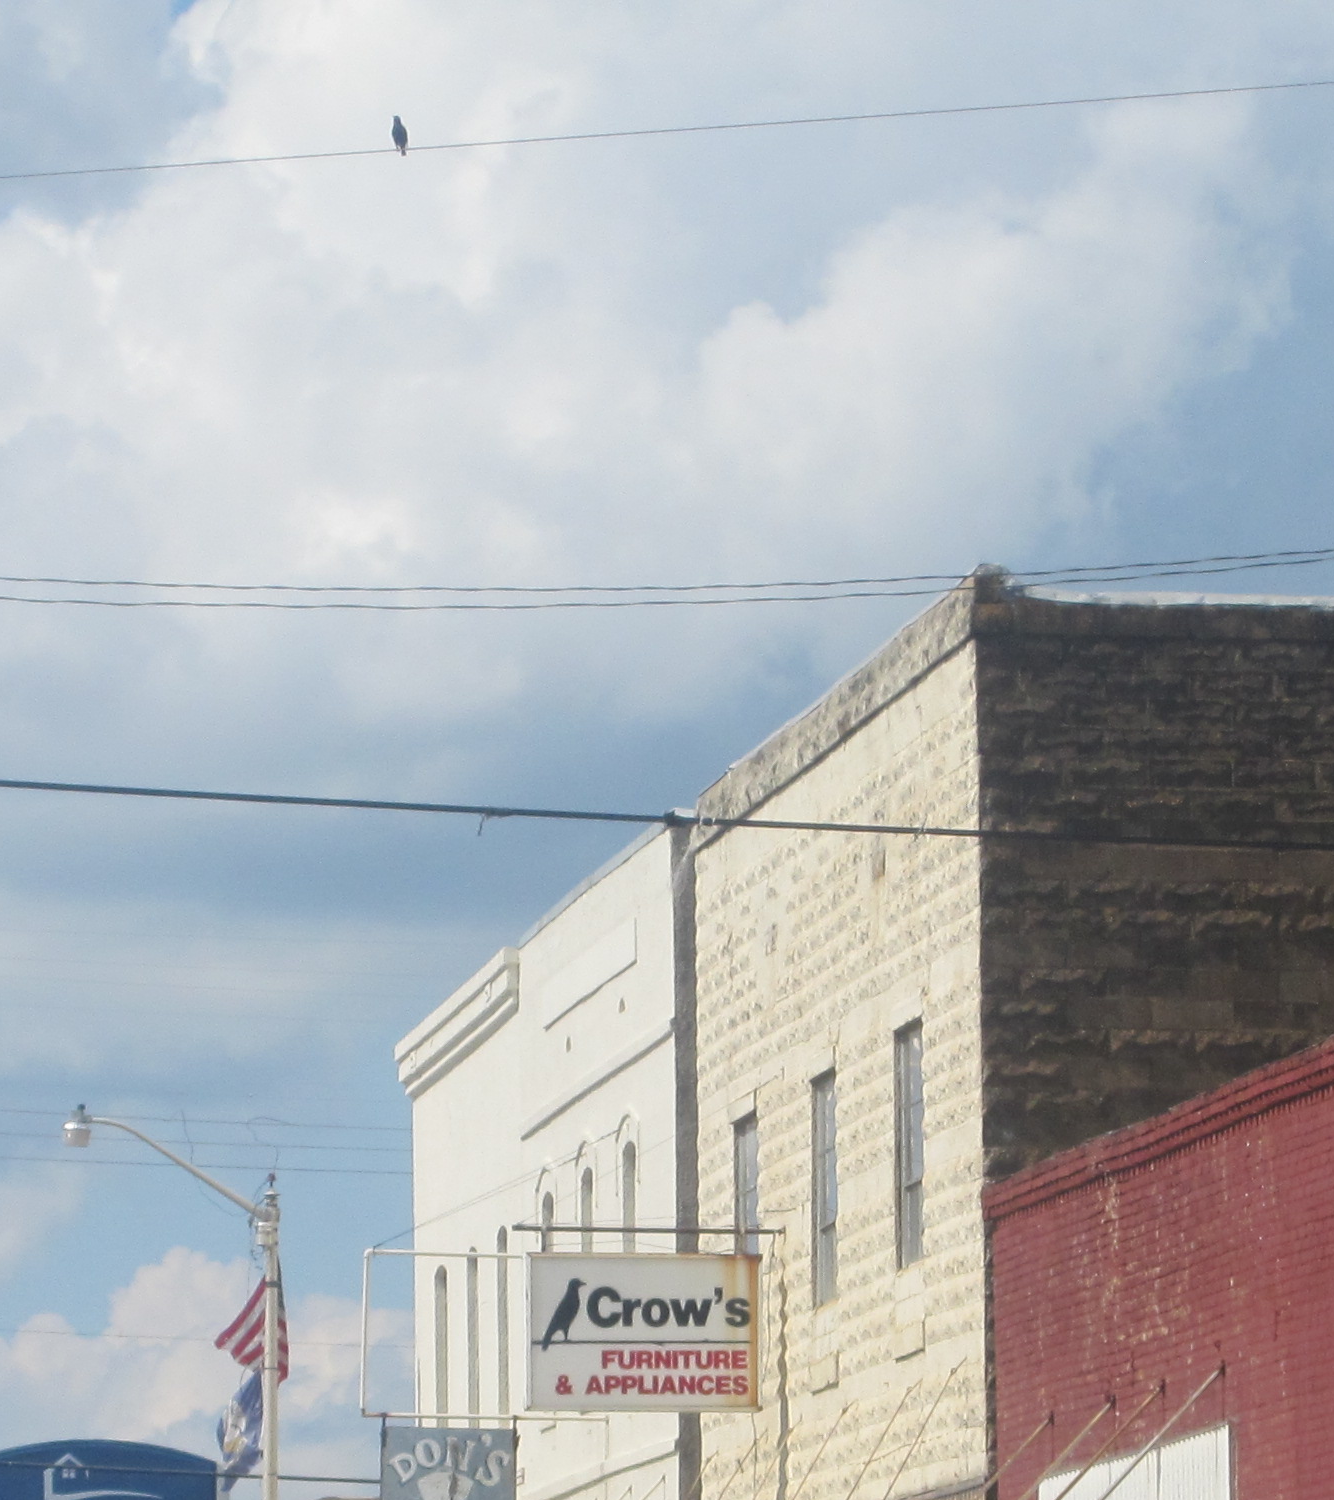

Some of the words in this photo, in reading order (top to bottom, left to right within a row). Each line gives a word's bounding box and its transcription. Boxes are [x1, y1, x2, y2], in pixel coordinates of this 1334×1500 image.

[586, 1286, 751, 1328] Crow's
[601, 1350, 748, 1370] FURNITURE
[555, 1375, 573, 1395] &
[585, 1375, 749, 1395] APPLIANCES
[388, 1433, 509, 1486] DON'S
